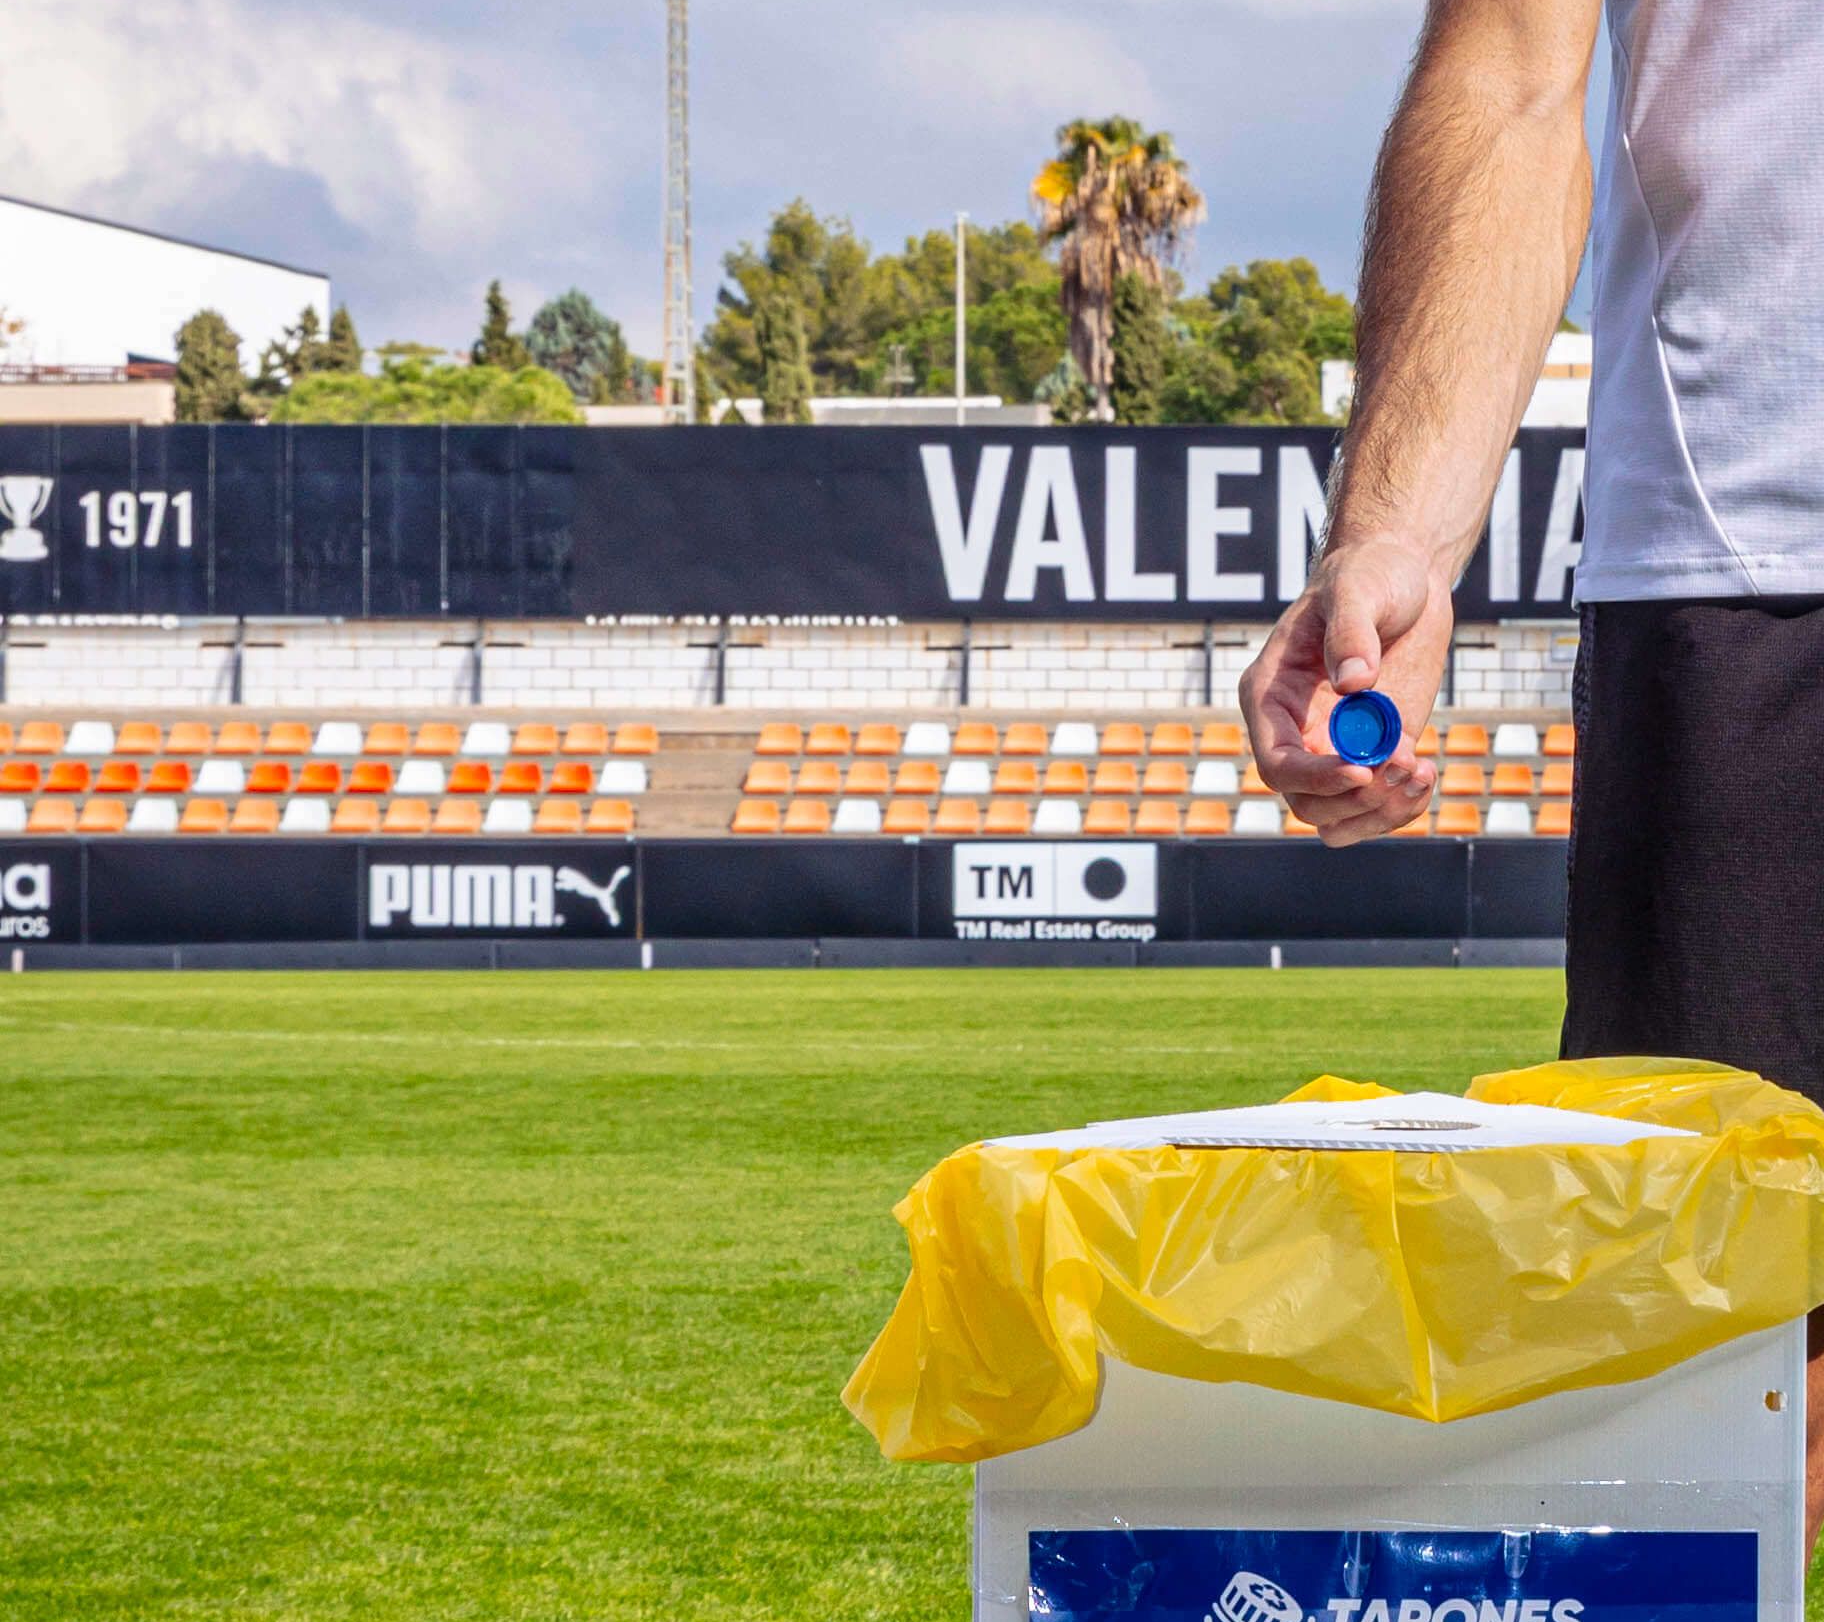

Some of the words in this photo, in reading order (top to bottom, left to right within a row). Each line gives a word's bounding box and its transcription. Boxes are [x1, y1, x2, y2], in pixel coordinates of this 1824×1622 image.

[79, 491, 192, 547] 1971
[369, 864, 554, 927] PUMA
[970, 866, 1033, 898] TM
[954, 920, 987, 939] TM
[990, 920, 1031, 939] Real
[1034, 920, 1093, 939] Estate
[1096, 920, 1156, 943] Group
